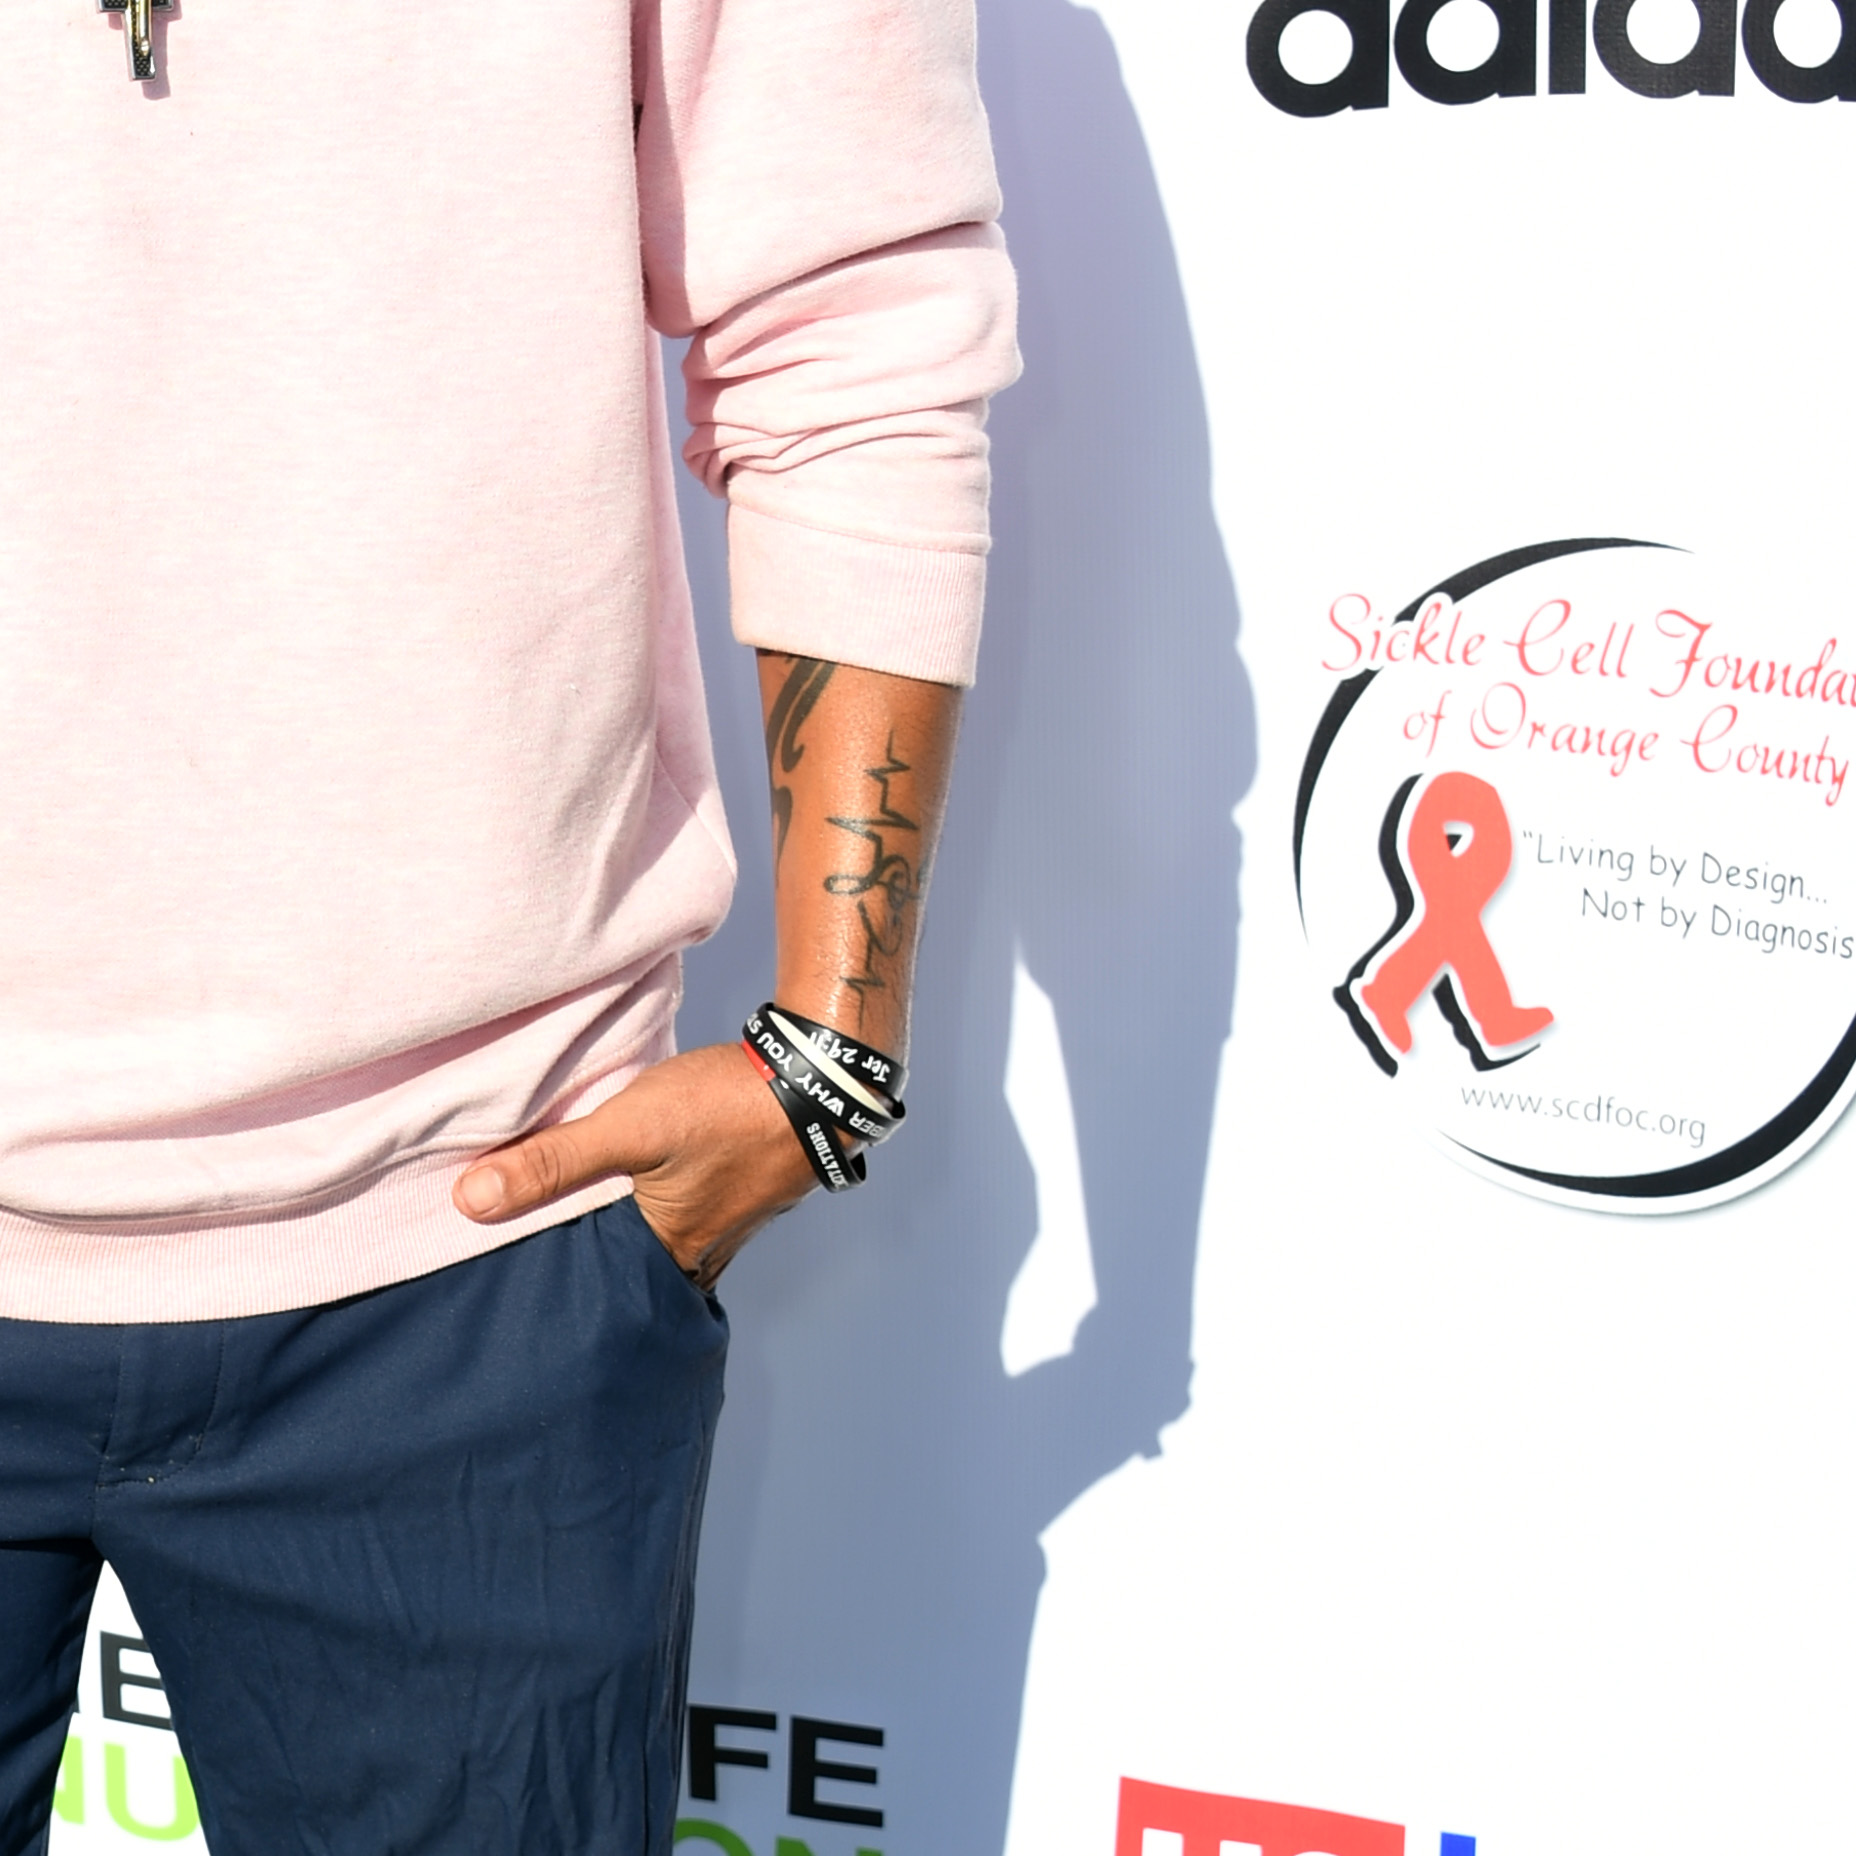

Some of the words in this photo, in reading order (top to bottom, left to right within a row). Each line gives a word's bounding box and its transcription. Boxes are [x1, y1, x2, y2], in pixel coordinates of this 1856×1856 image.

[1321, 592, 1486, 672] Sickle
[1503, 598, 1635, 680] Cell
[1402, 688, 1453, 758] of
[1469, 681, 1660, 777] Orange
[1679, 703, 1850, 808] County
[1649, 843, 1687, 888] by
[1700, 851, 1829, 906] Design...
[1581, 887, 1647, 924] Not
[1660, 895, 1698, 939] by
[1711, 904, 1854, 960] Diagnosis
[755, 1031, 795, 1073] YOU
[794, 1073, 845, 1118] WHY
[1459, 1084, 1707, 1149] www.scdfoc.org
